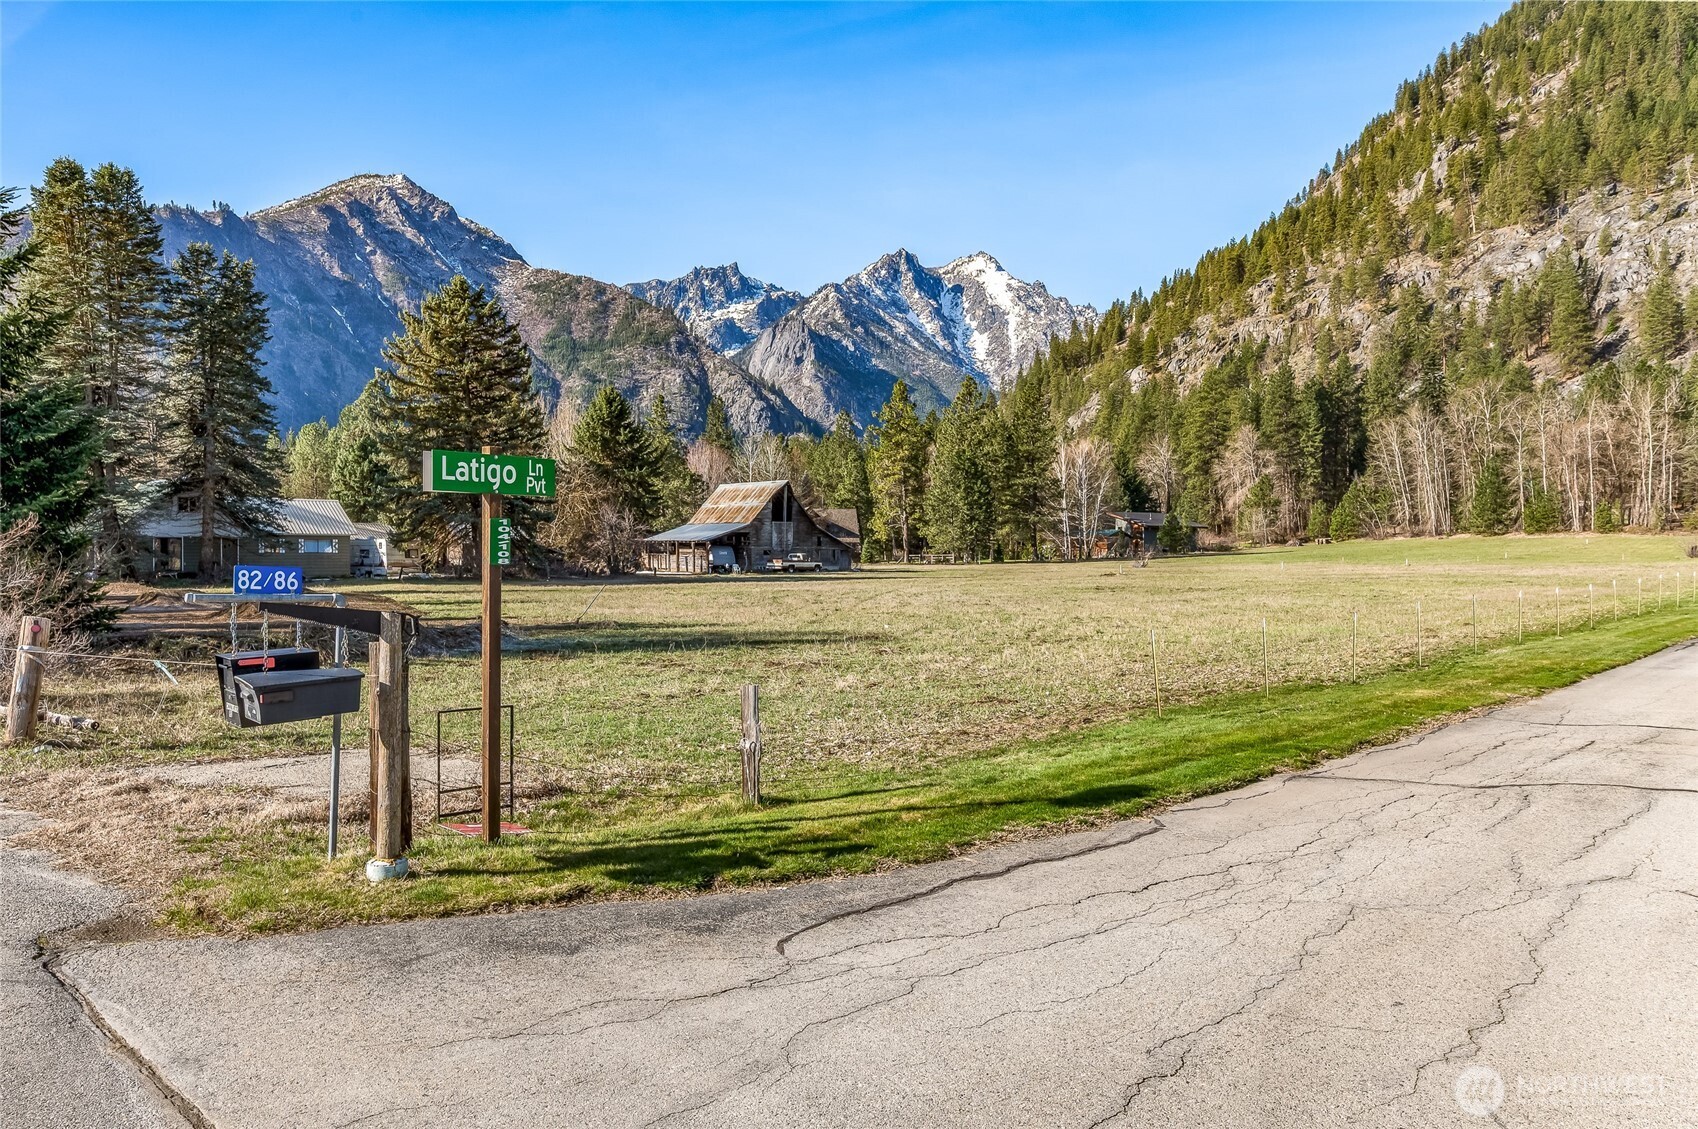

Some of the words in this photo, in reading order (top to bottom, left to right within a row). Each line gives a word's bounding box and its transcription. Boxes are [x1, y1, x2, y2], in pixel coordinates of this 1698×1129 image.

[441, 455, 517, 490] Latigo
[528, 459, 544, 477] Ln
[526, 477, 546, 494] Pvt
[497, 518, 511, 565] 104/108
[237, 569, 299, 591] 82/86
